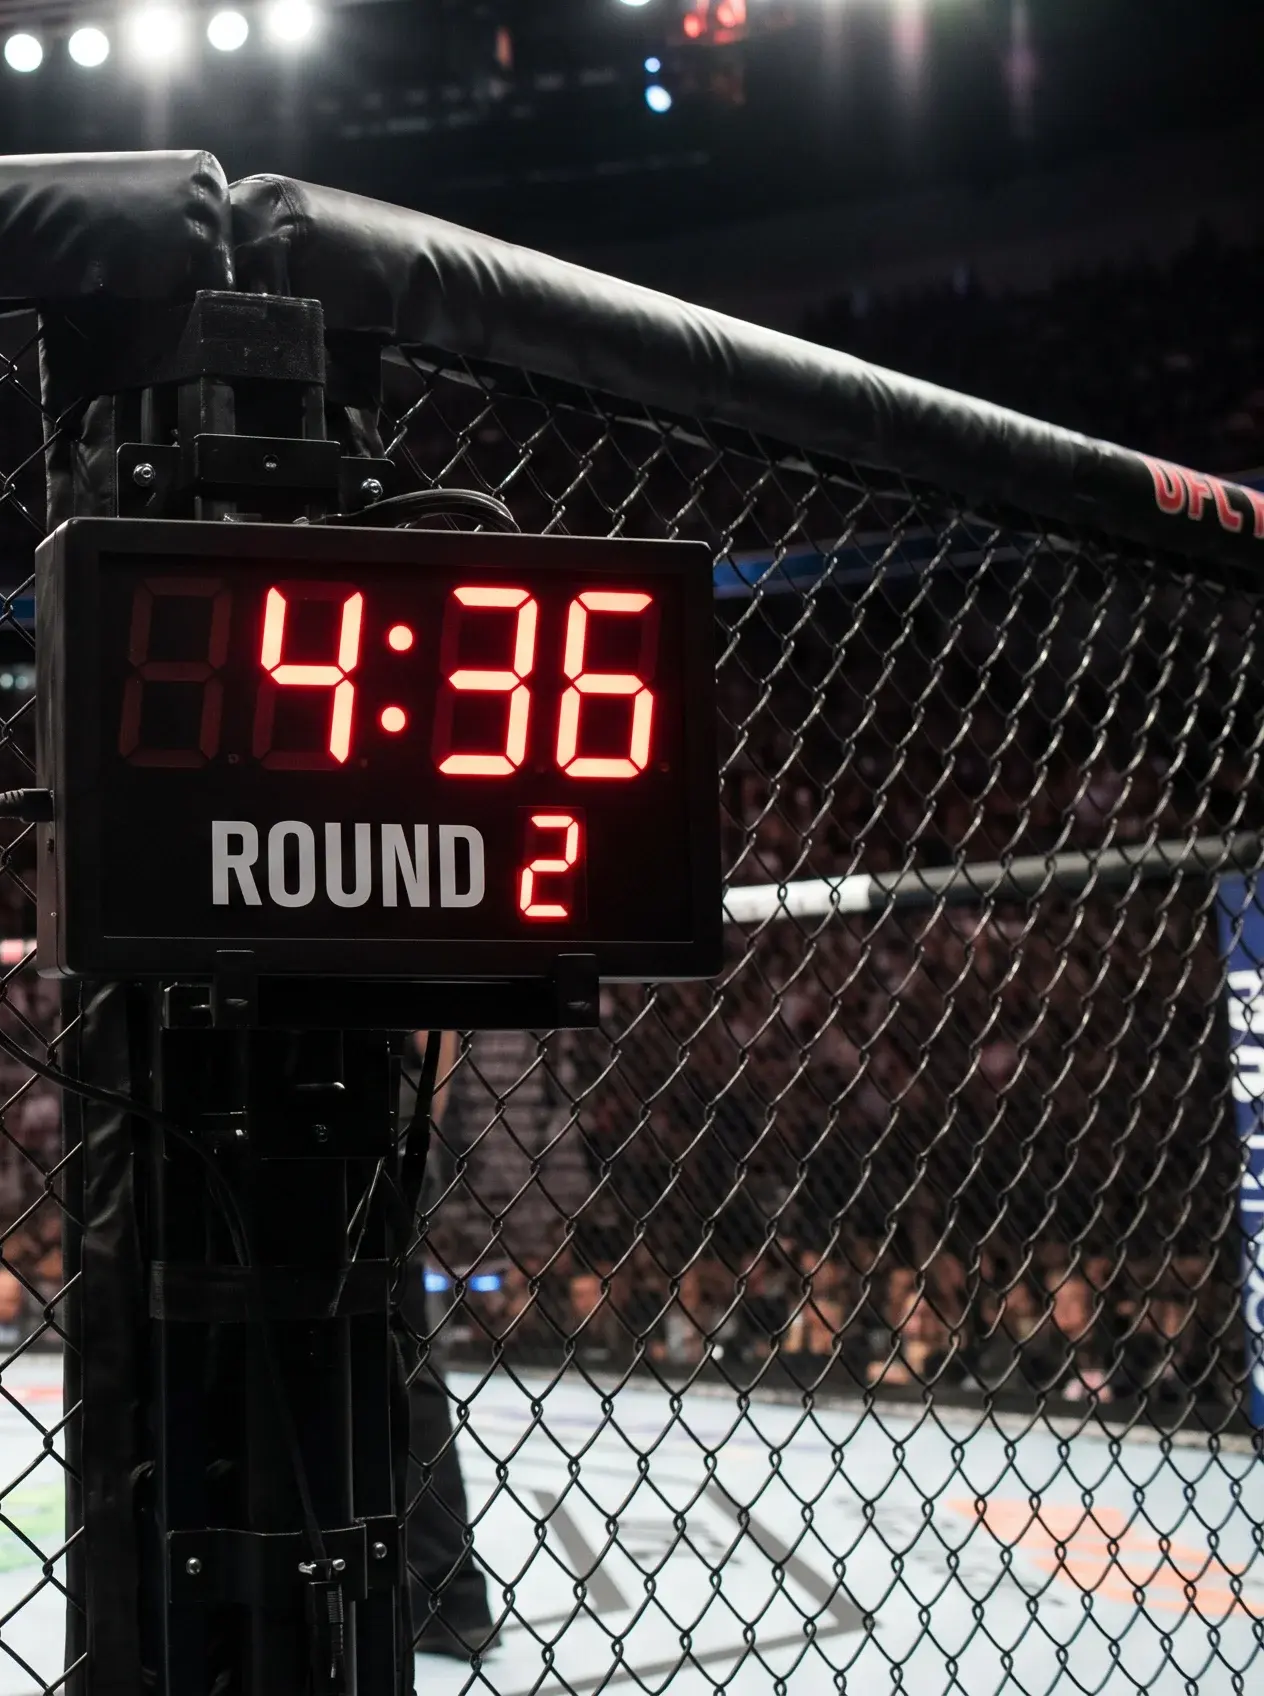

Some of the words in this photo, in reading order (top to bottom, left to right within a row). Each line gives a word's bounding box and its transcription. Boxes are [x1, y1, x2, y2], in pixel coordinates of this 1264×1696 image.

[260, 584, 654, 779] 4:36
[211, 819, 486, 909] ROUND
[519, 815, 579, 918] 2
